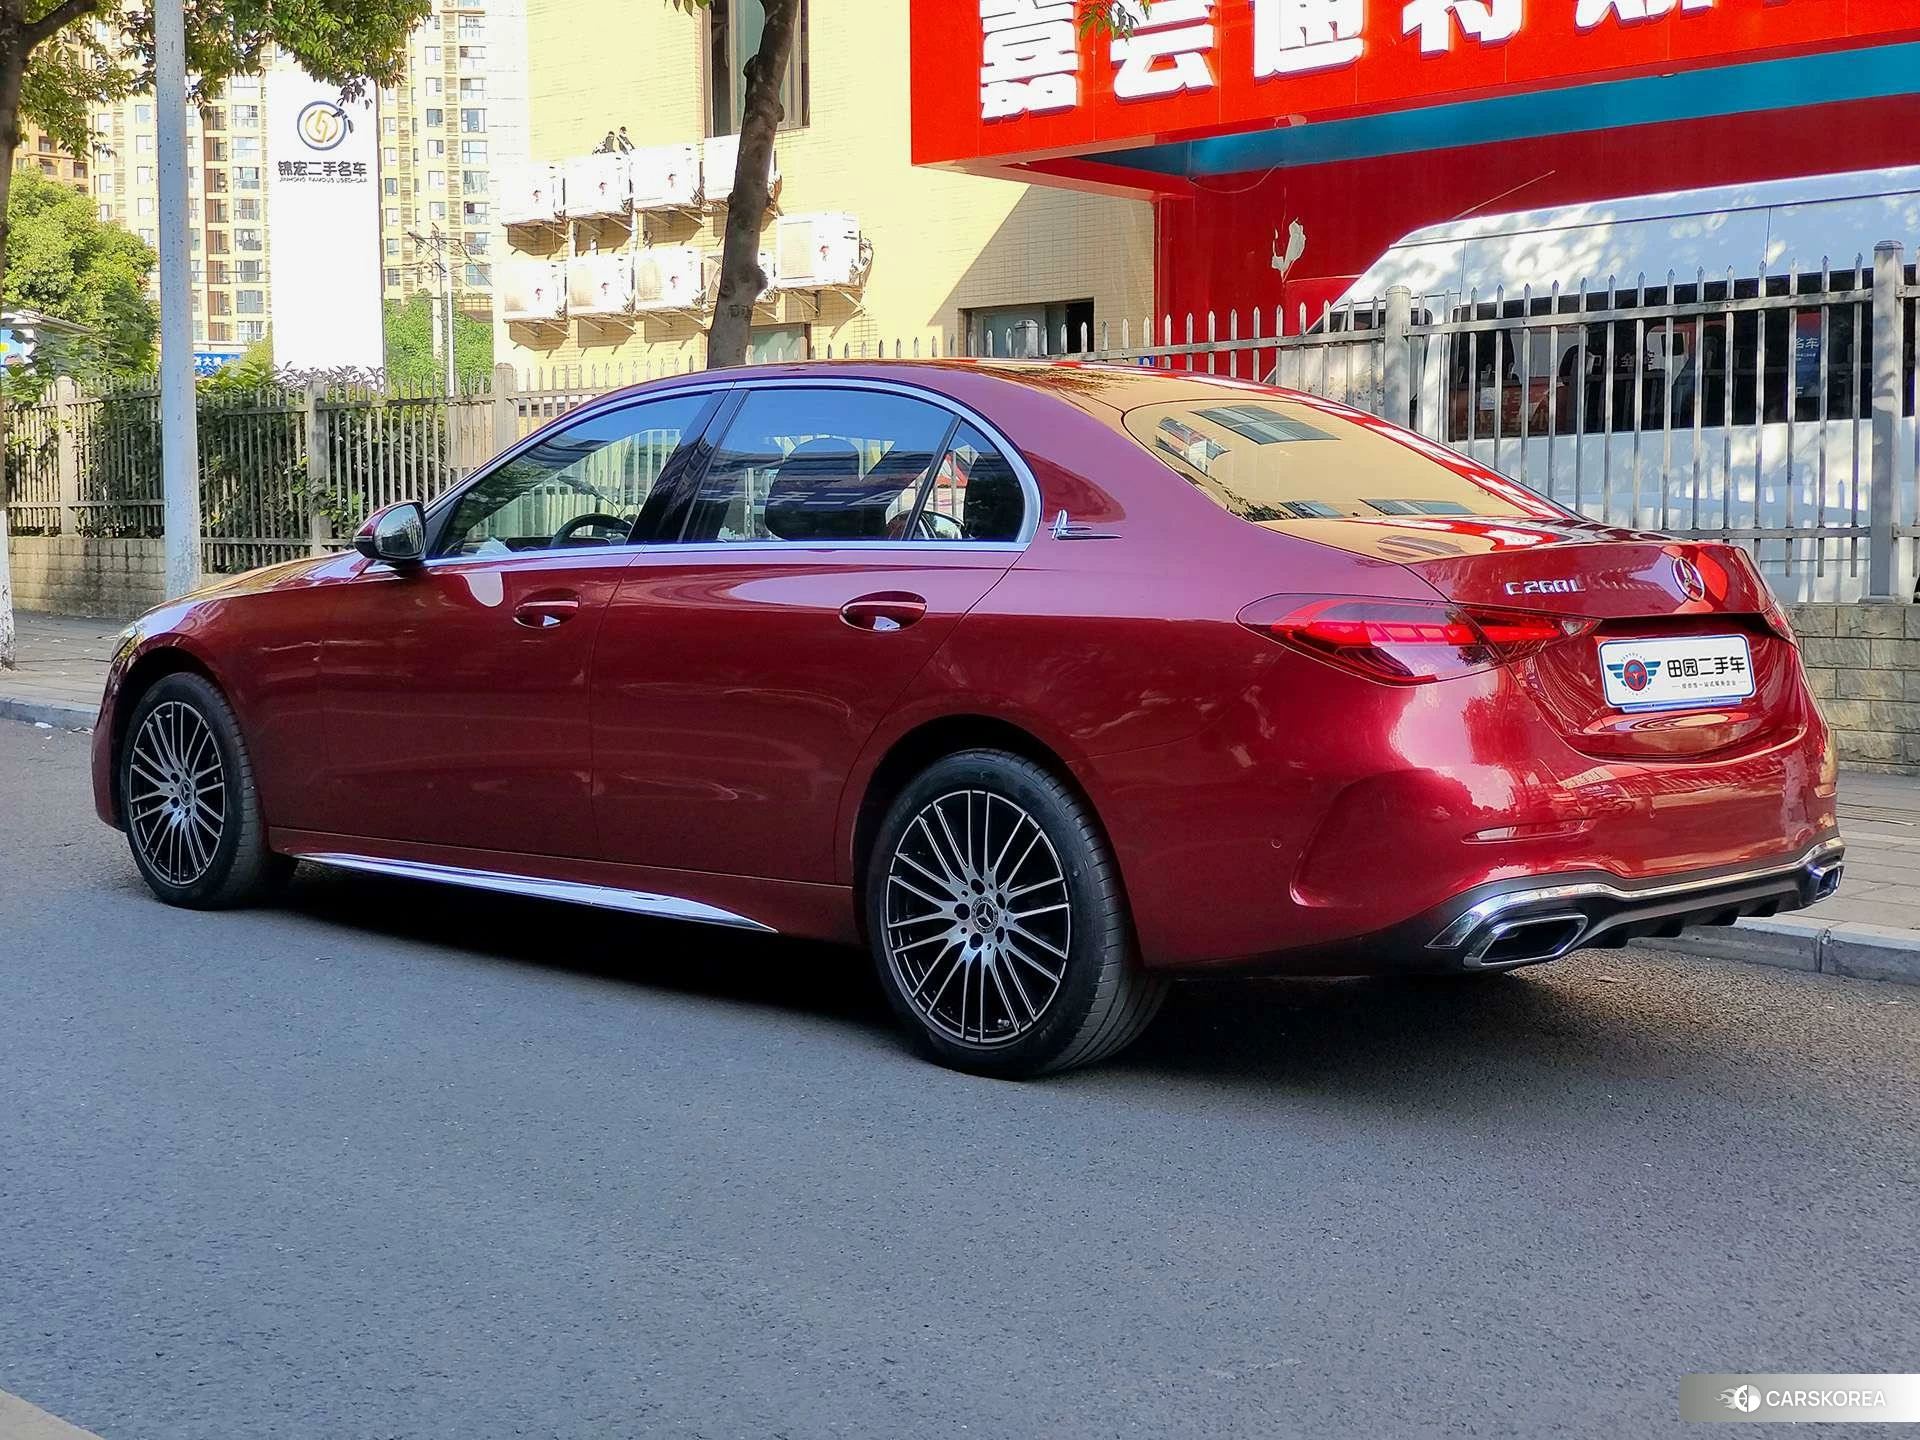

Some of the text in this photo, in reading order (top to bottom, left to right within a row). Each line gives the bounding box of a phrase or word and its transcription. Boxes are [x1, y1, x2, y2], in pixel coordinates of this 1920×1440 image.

[278, 161, 367, 176] 锦宏二手名车
[1667, 656, 1746, 678] 田园二手车
